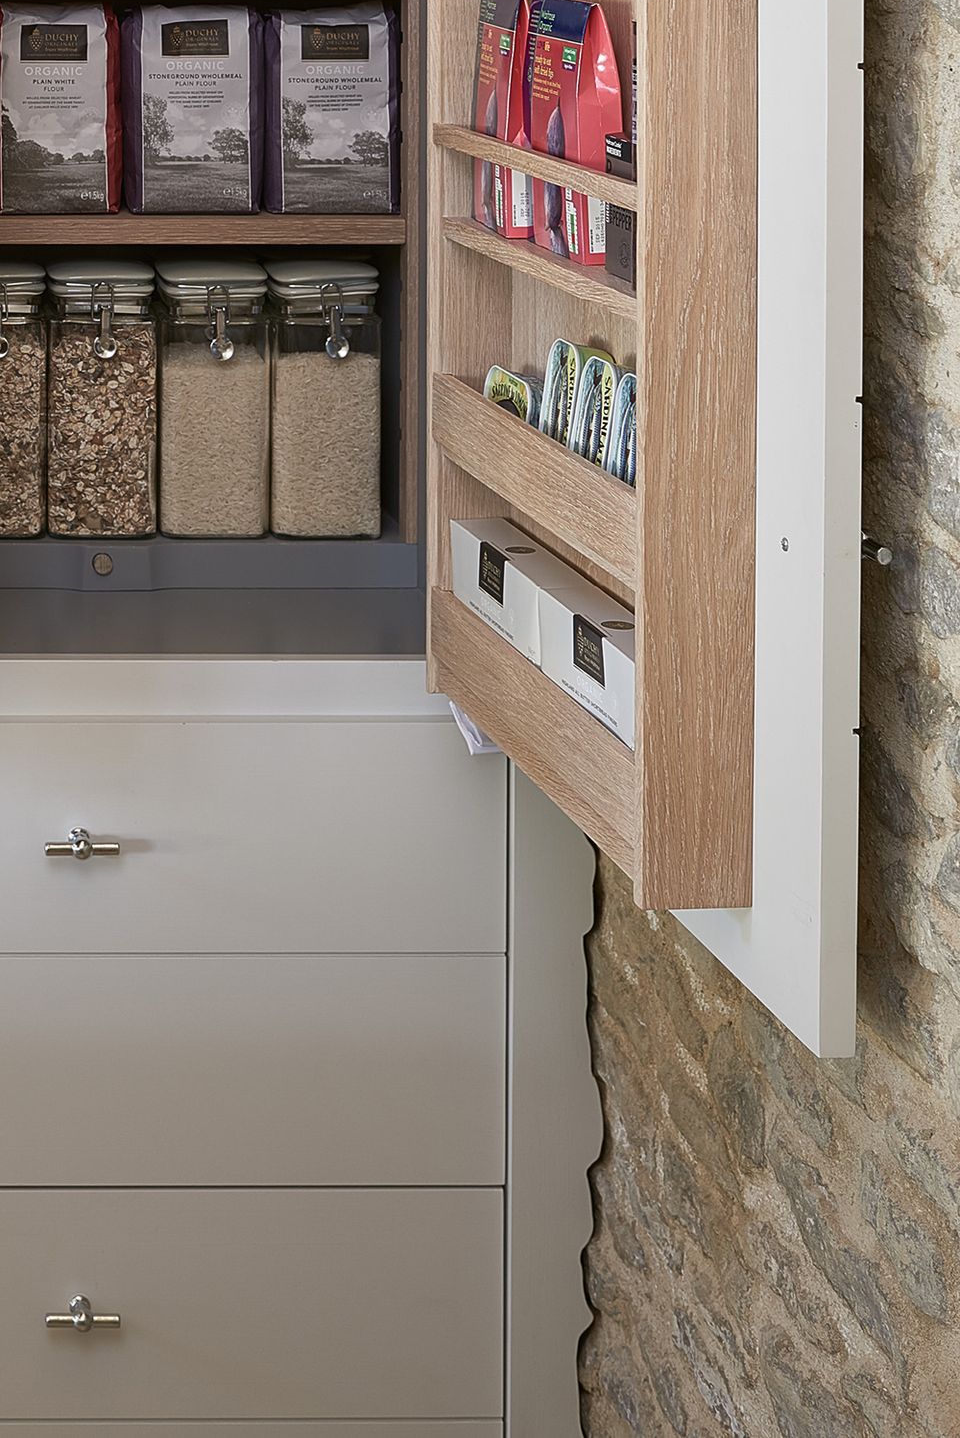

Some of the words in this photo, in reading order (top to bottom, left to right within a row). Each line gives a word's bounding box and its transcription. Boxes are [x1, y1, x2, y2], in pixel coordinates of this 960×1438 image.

[185, 28, 219, 37] DUCHY
[326, 32, 360, 41] DUCHY
[45, 33, 79, 42] DUCHY
[166, 61, 225, 71] ORGANIC
[305, 65, 365, 75] ORGANIC
[24, 66, 83, 76] ORGANIC
